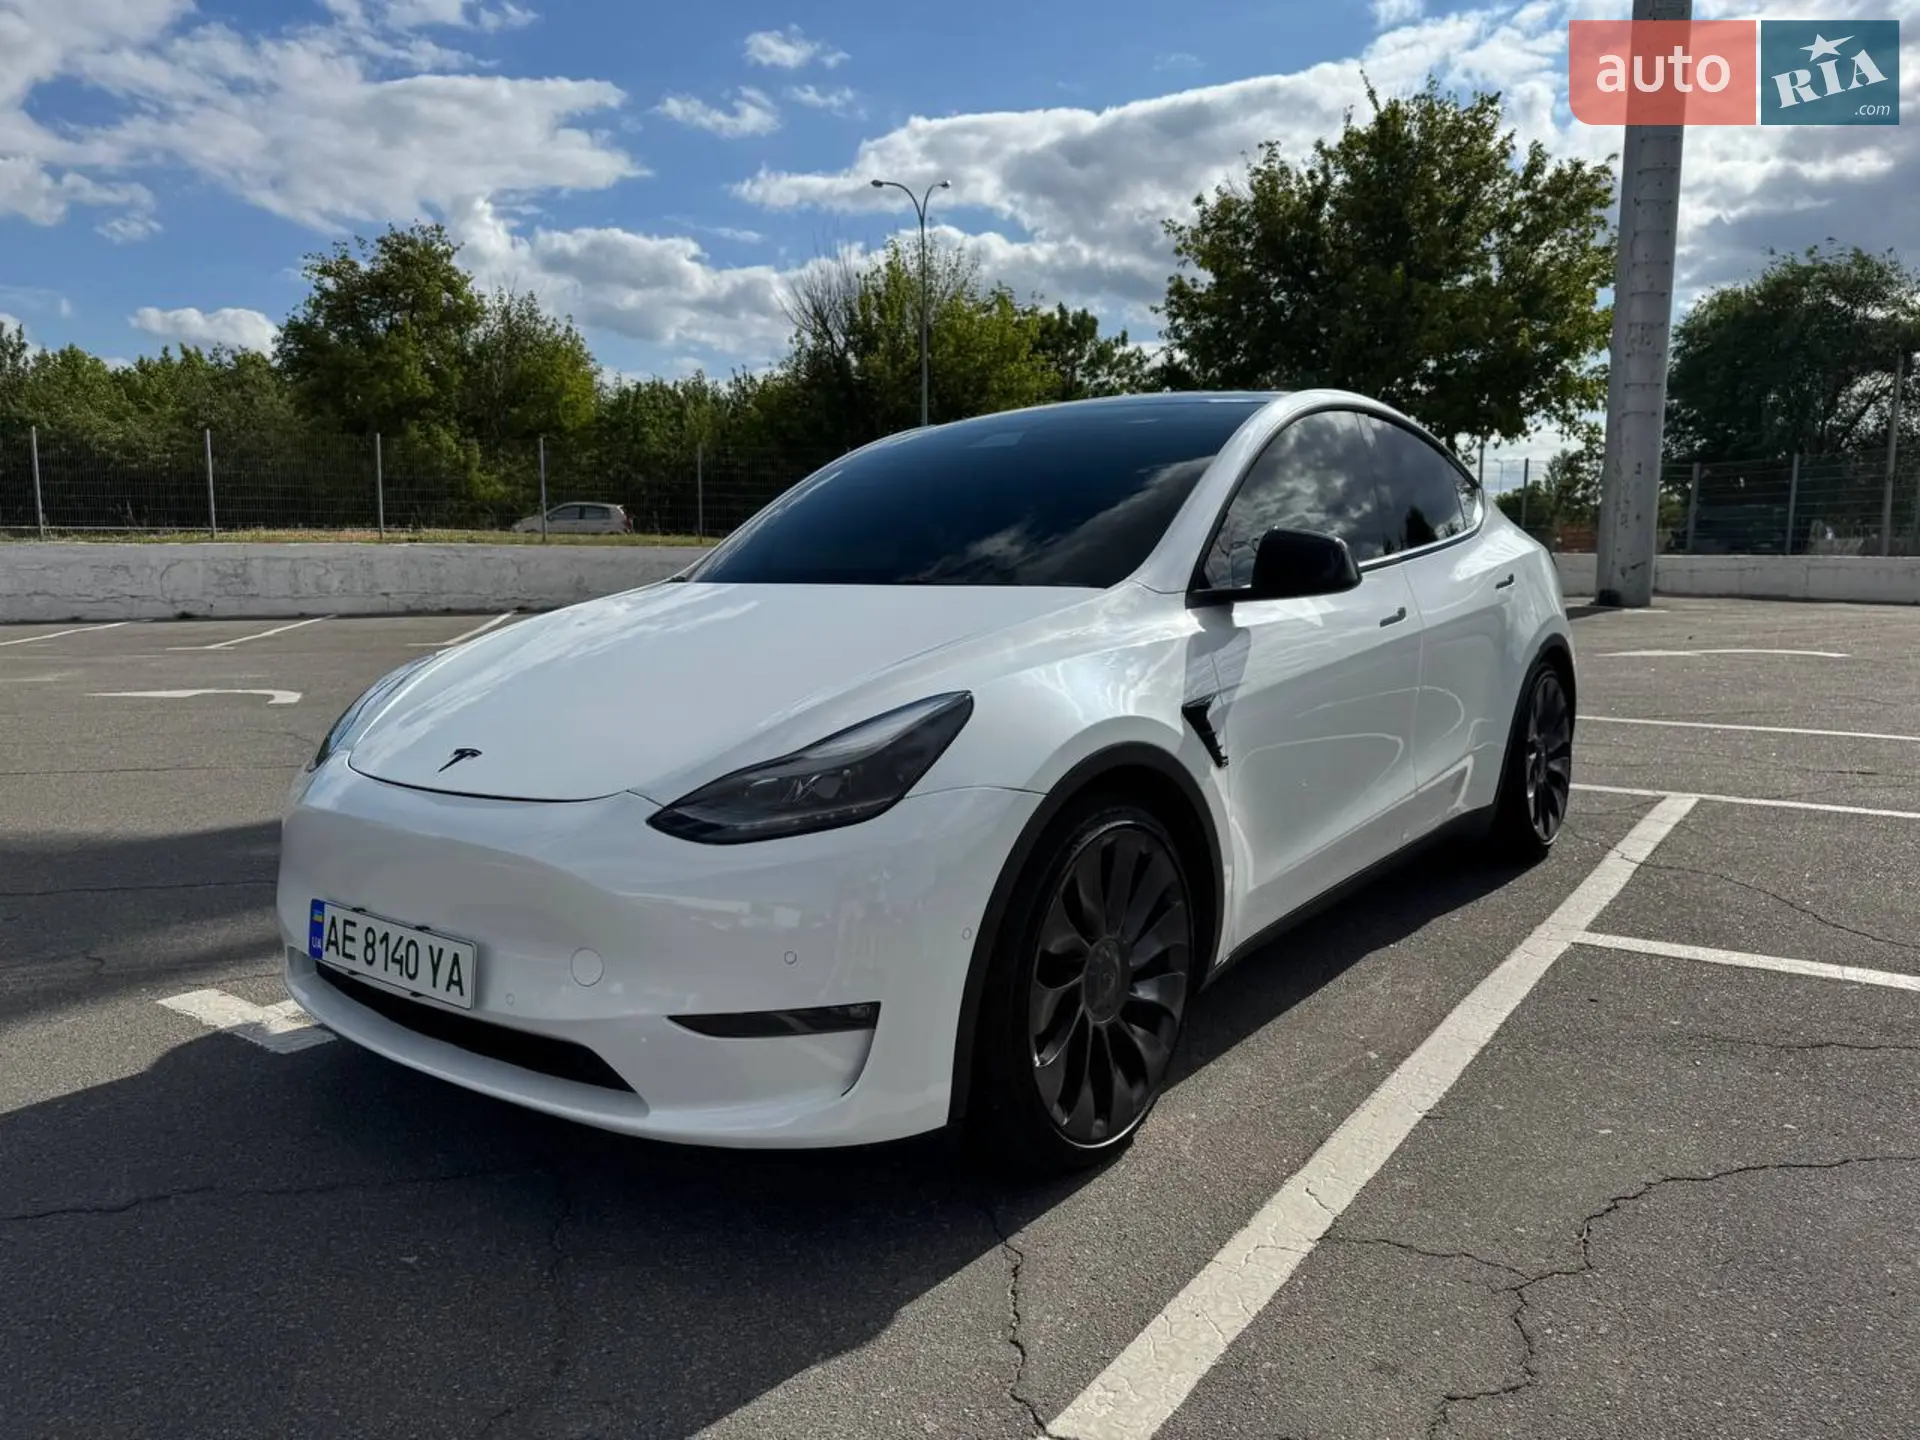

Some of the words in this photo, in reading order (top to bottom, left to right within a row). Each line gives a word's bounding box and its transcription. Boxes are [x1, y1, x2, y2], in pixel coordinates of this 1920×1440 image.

[325, 915, 356, 961] AE
[363, 926, 419, 981] 8140
[428, 945, 464, 997] YA
